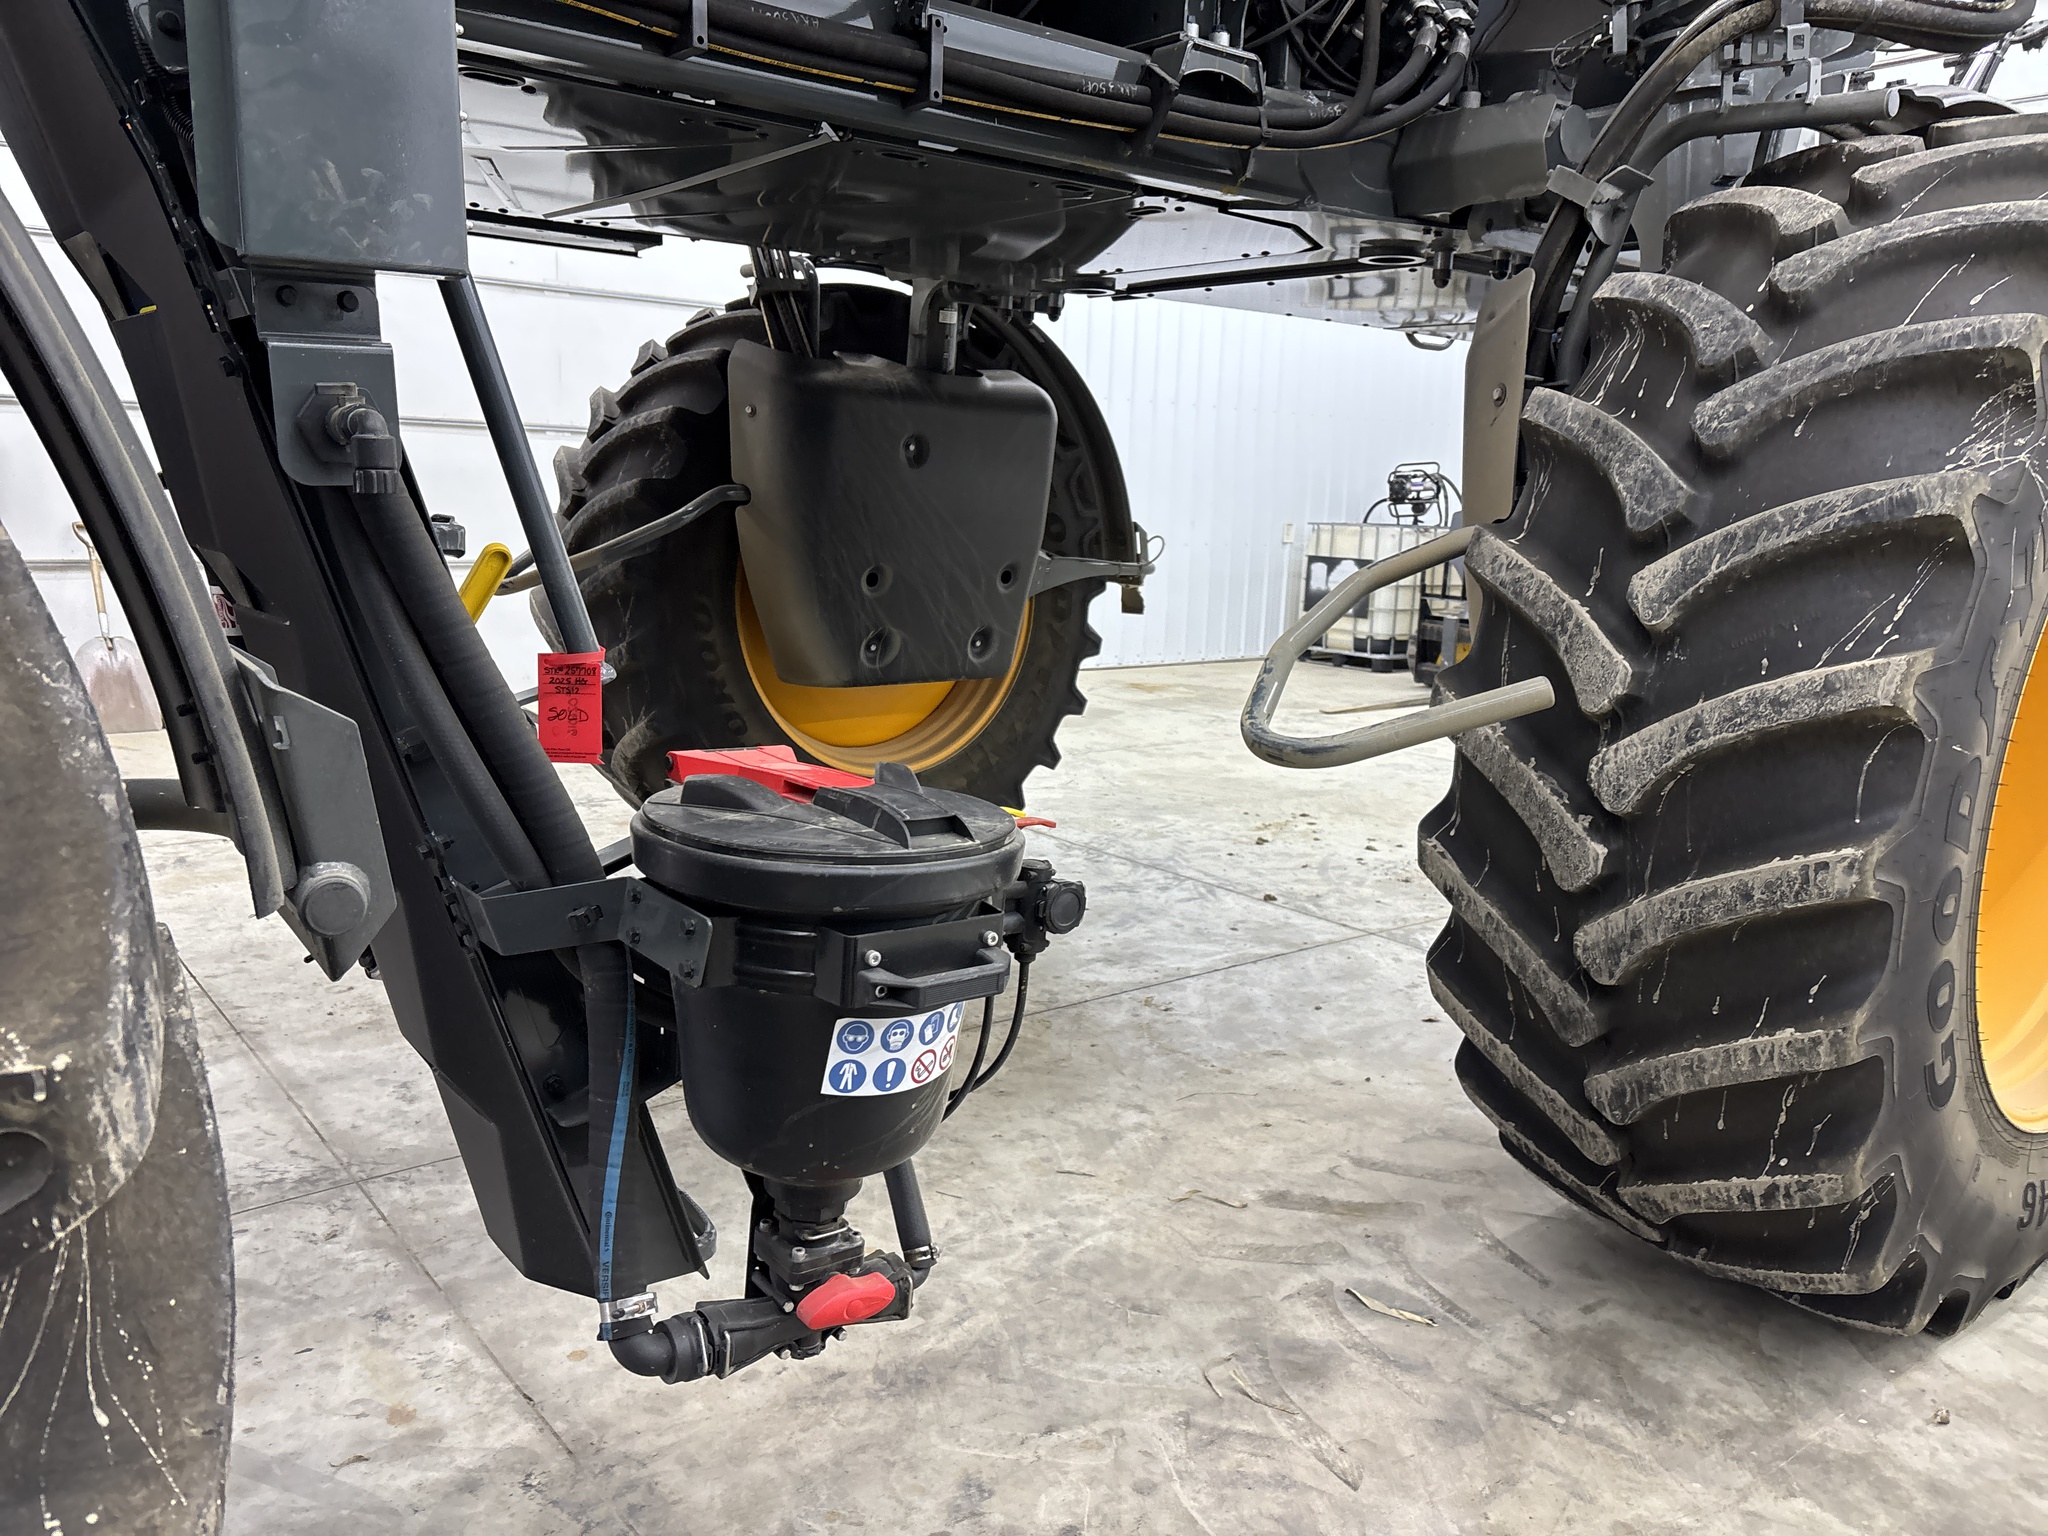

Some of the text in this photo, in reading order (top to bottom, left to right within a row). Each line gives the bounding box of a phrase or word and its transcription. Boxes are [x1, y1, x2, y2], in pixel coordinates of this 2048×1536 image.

[549, 677, 571, 685] 2025
[555, 686, 579, 695] STS12
[547, 707, 589, 722] SOLD
[604, 1211, 612, 1247] Continental
